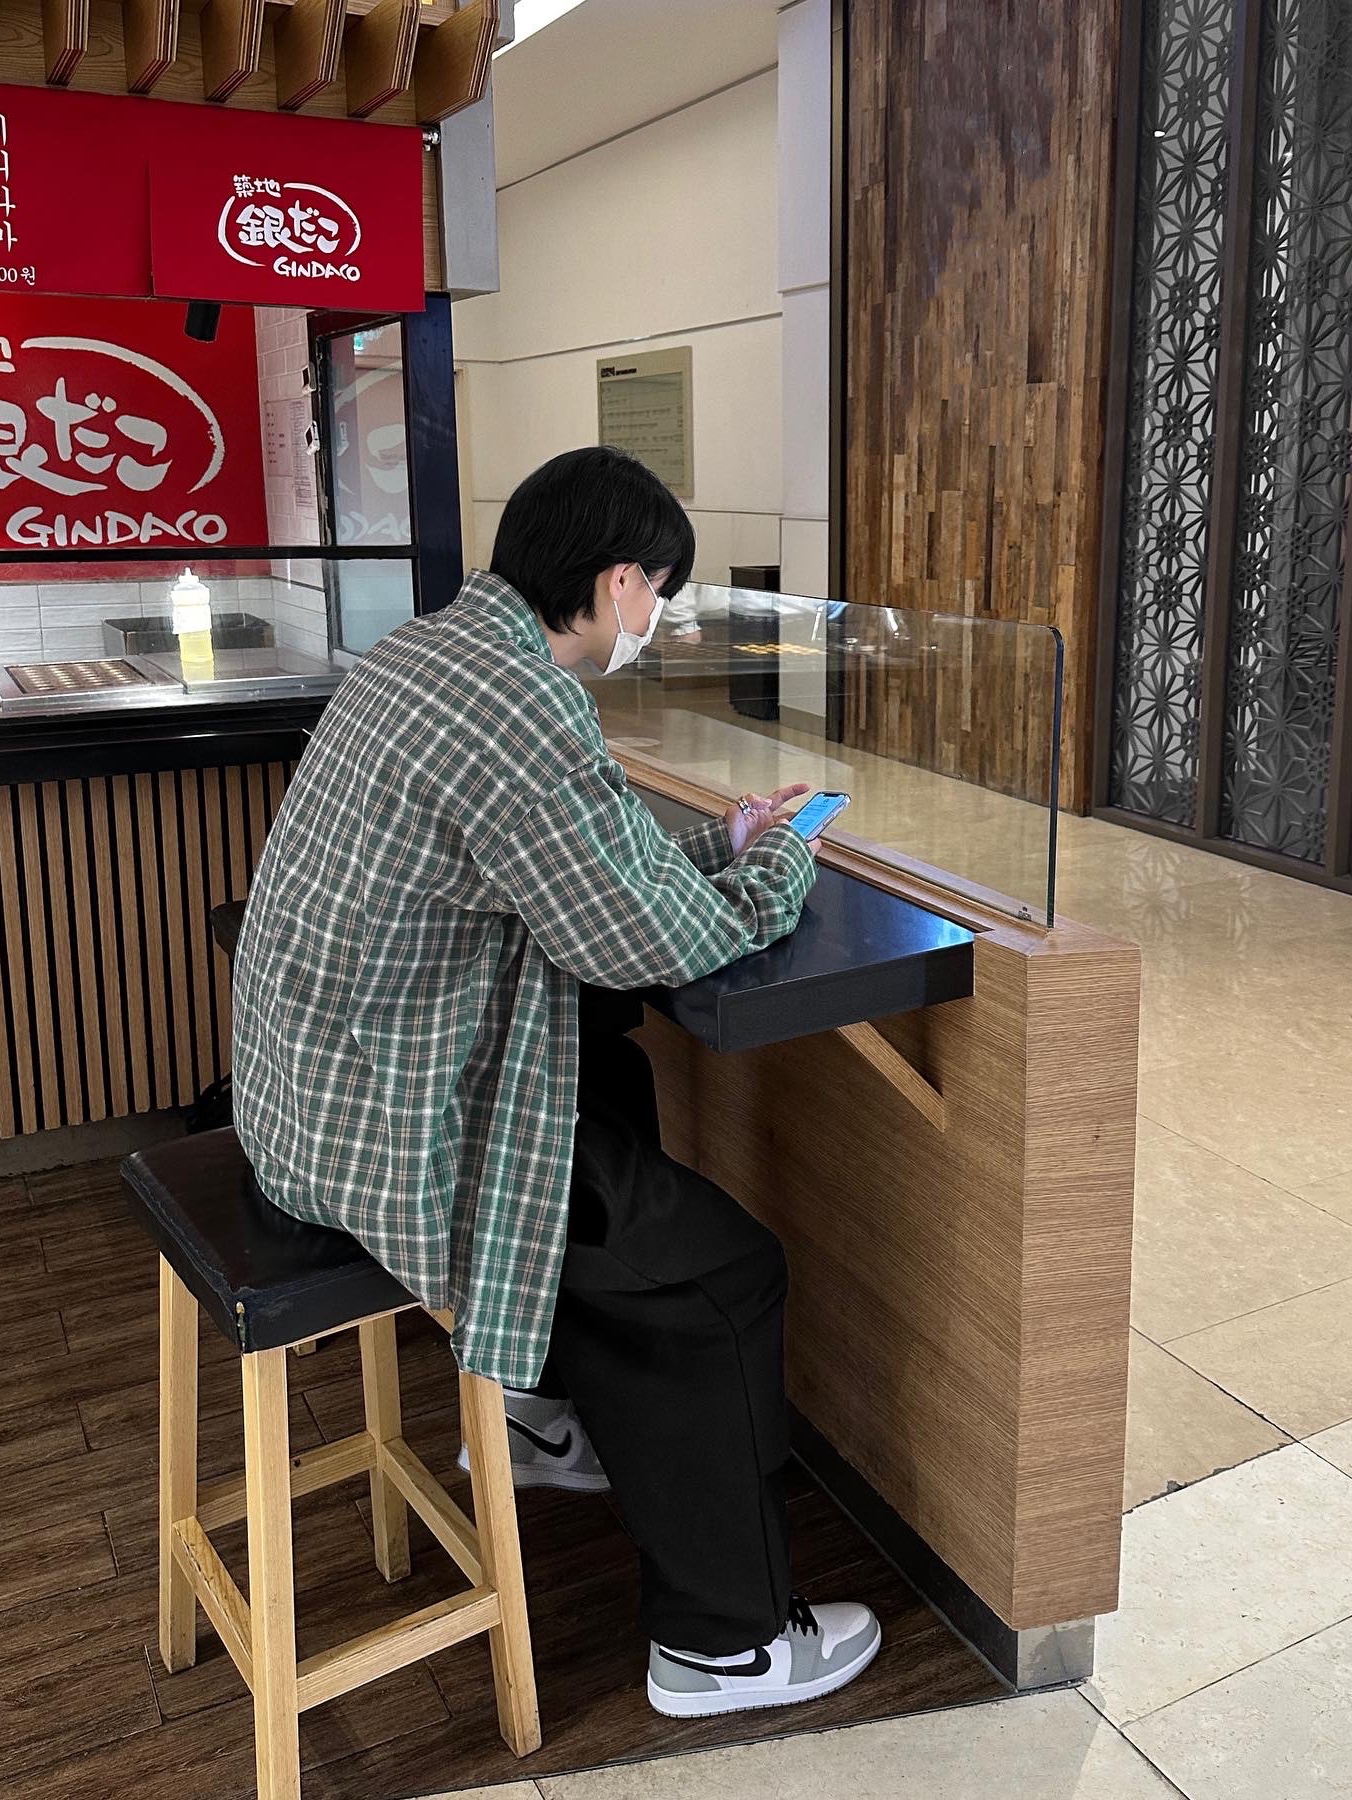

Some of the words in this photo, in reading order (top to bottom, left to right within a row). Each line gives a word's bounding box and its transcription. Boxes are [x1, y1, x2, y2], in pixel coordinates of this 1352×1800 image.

[233, 174, 281, 198] 築地
[236, 200, 340, 254] 銀だこ
[273, 256, 361, 282] GINDACO
[6, 506, 228, 547] GINDACO
